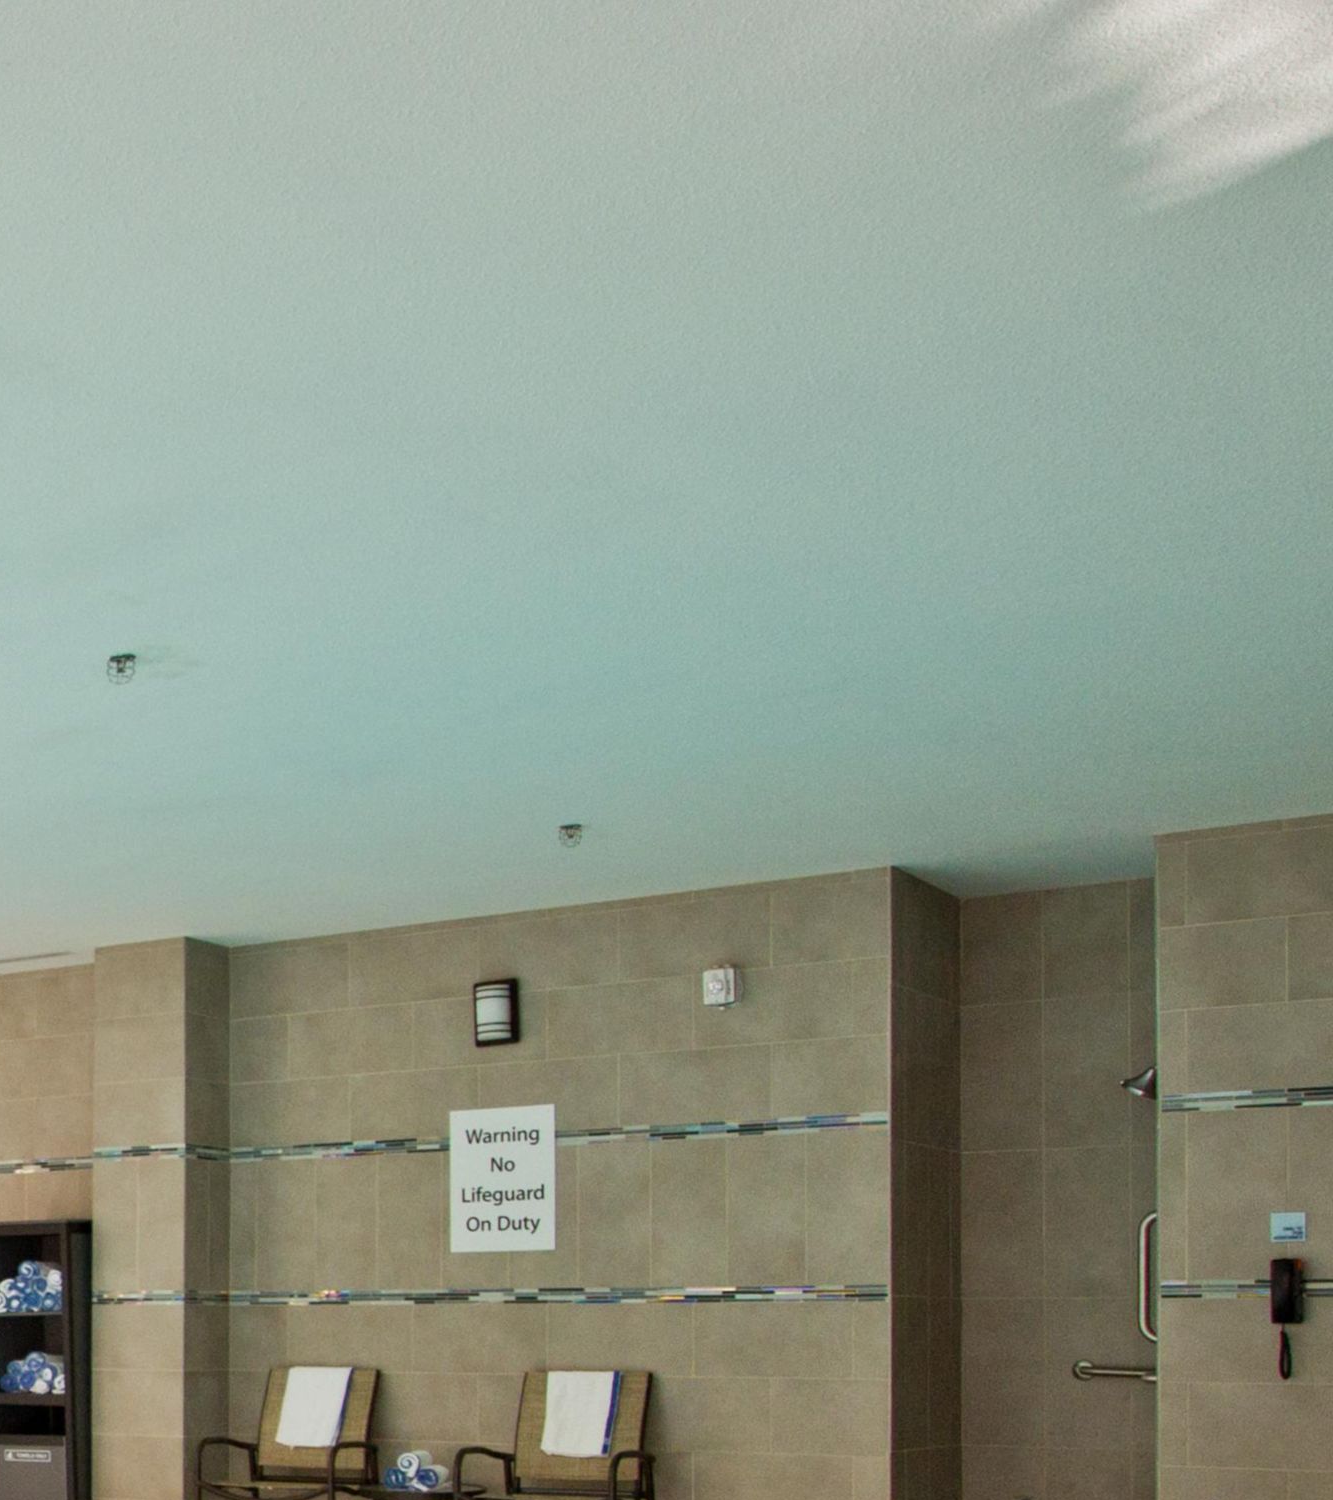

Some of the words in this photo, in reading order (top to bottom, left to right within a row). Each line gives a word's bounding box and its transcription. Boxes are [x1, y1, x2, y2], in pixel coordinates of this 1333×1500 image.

[465, 1127, 540, 1145] Warning
[490, 1157, 515, 1172] No
[461, 1184, 545, 1206] Lifeguard
[466, 1217, 491, 1232] On
[497, 1215, 541, 1234] Duty
